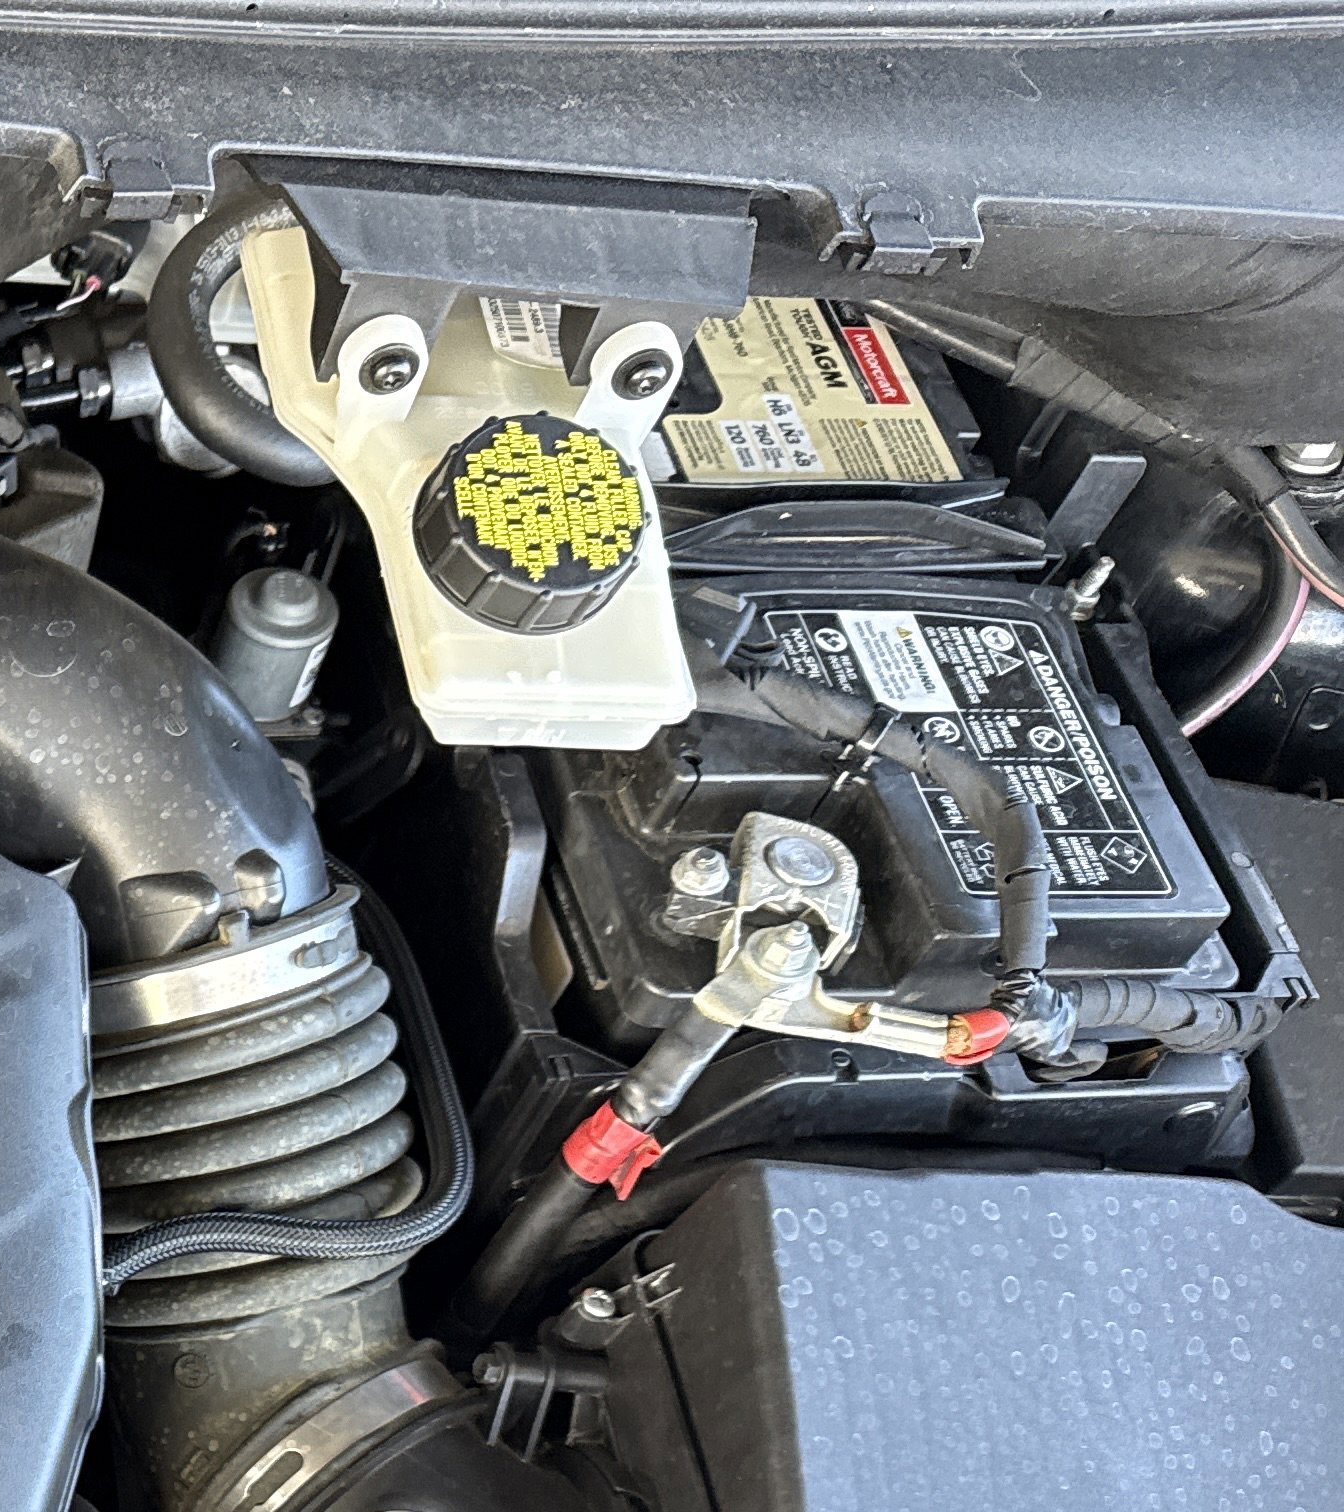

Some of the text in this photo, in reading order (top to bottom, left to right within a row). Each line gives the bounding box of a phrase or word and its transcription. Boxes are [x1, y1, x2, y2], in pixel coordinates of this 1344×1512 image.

[806, 341, 848, 388] AGM
[852, 333, 898, 399] Motorcraft
[506, 421, 525, 455] AVANT
[554, 440, 570, 449] A
[568, 431, 588, 459] ONLY
[725, 424, 746, 444] 120
[752, 424, 774, 446] 760
[767, 400, 783, 416] H6
[778, 422, 801, 444] LN3
[793, 450, 812, 467] 48
[480, 449, 499, 470] DOT
[513, 458, 529, 473] DE
[557, 452, 579, 492] SEALED
[575, 463, 592, 484] DOT
[466, 454, 495, 545] D'UN CONTENANT
[492, 433, 528, 567] PLOYER QUE DU LIQUIDE
[516, 477, 533, 491] LE
[523, 434, 559, 566] NETTOYER LE BOUCHON
[585, 435, 606, 476] BEFORE
[602, 543, 620, 566] USE
[602, 450, 633, 552] CLEAN FILLER CAP
[486, 487, 511, 550] PROVENANT
[581, 502, 599, 533] FLUID
[586, 538, 606, 570] FROM
[924, 626, 936, 637] OR
[937, 626, 949, 641] CAN
[943, 642, 961, 664] CAUSE
[964, 626, 984, 653] SHIELD
[790, 628, 825, 684] NON-SPIL
[841, 655, 858, 680] READ
[903, 639, 936, 694] WARNING!
[948, 626, 989, 694] EXPLOSIVE GASES
[828, 655, 855, 694] INSTRUC
[970, 721, 993, 754] SMOKING
[983, 721, 1004, 749] FLAMES
[996, 721, 1017, 749] SPARKS
[1006, 716, 1021, 727] NO
[1035, 664, 1118, 801] DANGER/POISON
[1016, 765, 1044, 806] CAN CAUSE
[1030, 765, 1068, 826] SULFURIC ACID
[1056, 836, 1074, 856] WITH
[1067, 837, 1101, 885] IMMEDIATELY
[1079, 837, 1100, 861] FLUSH
